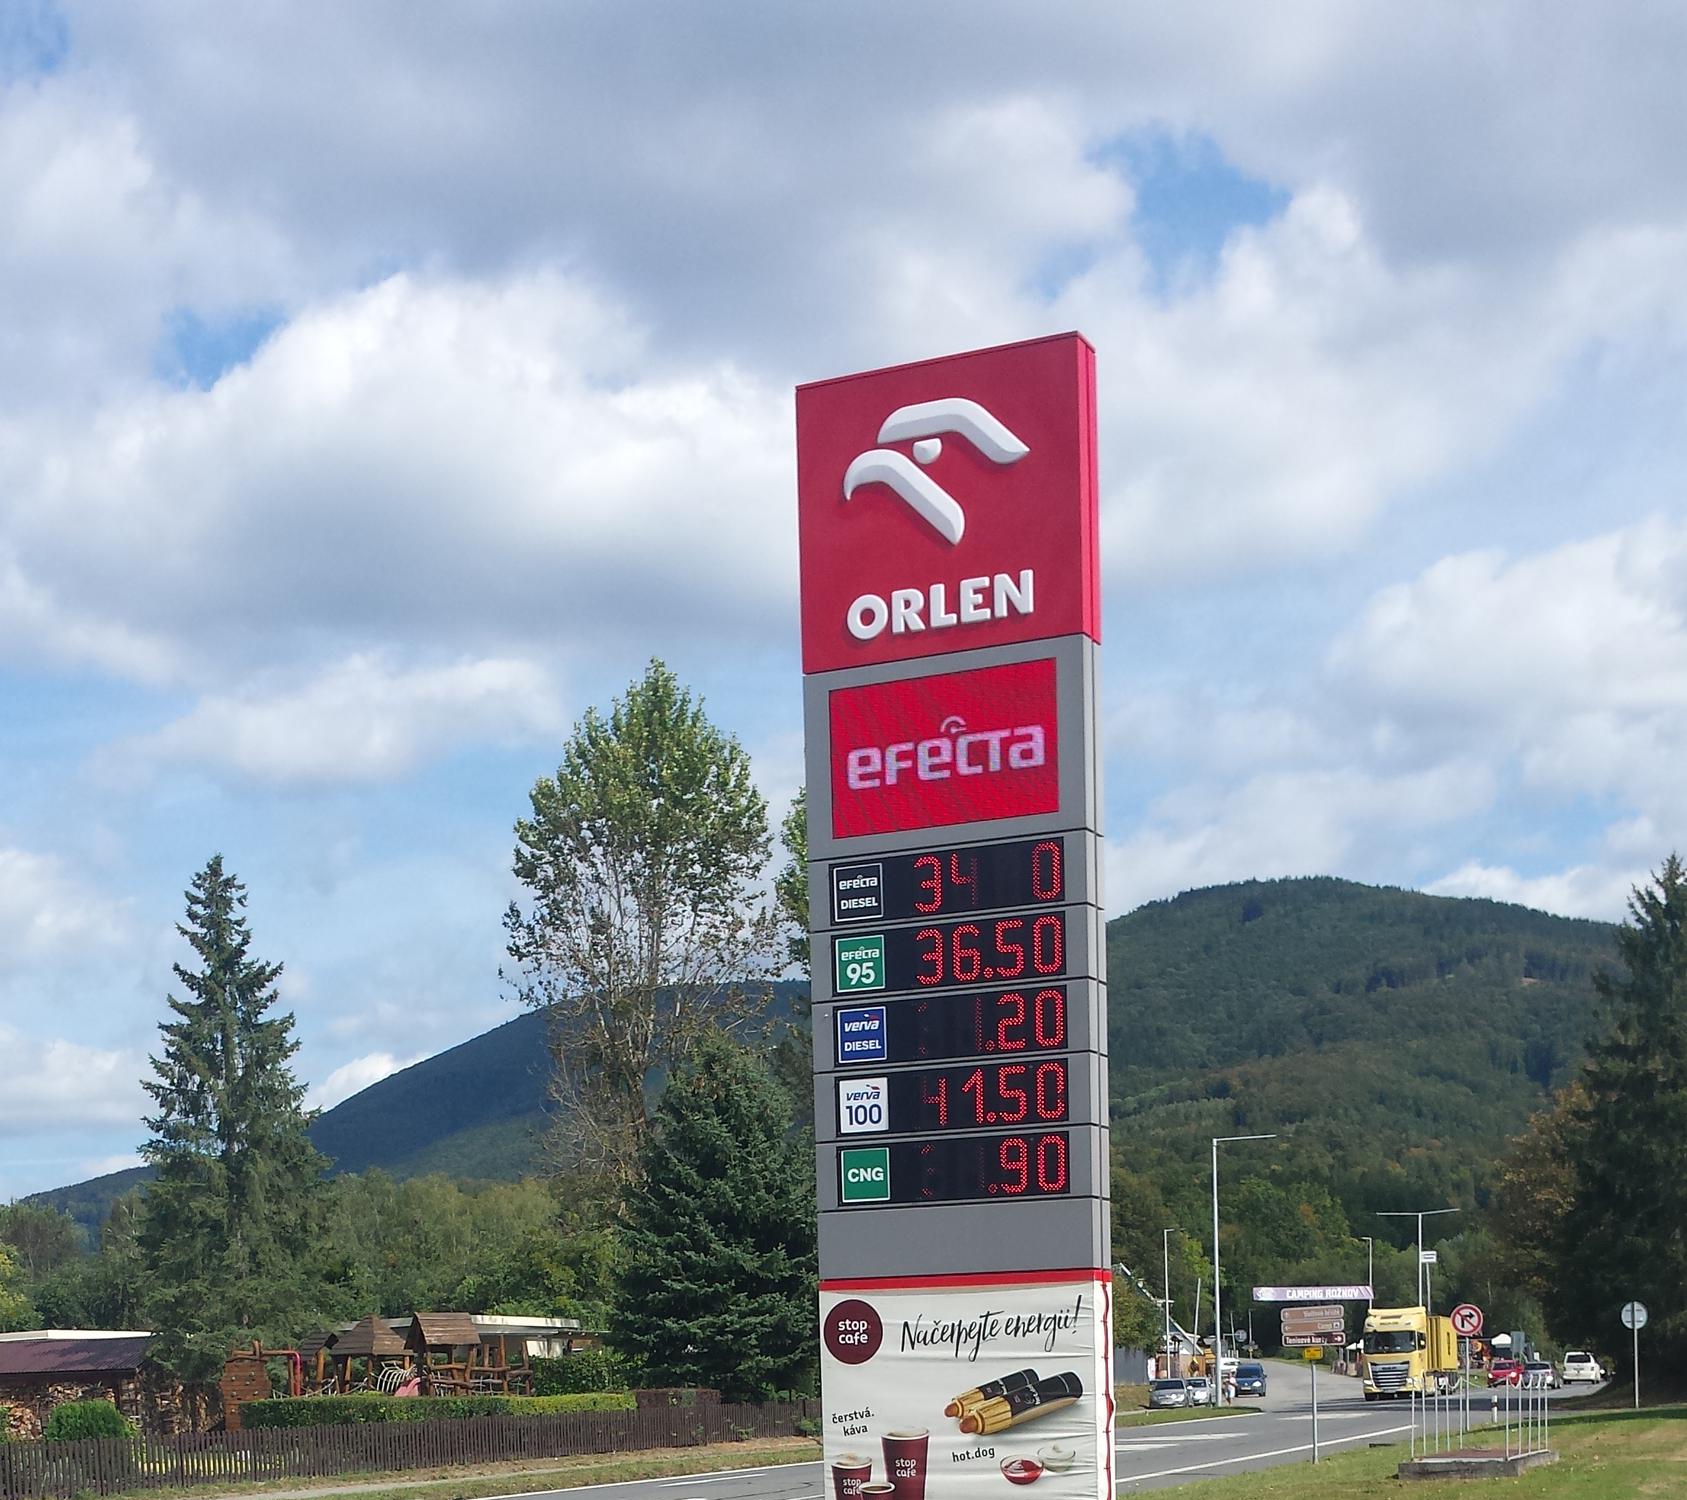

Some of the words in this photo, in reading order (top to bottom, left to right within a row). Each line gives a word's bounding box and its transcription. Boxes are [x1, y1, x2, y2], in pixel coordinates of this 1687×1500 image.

[847, 569, 1034, 640] ORLEN
[847, 717, 1045, 790] efecta
[839, 875, 878, 890] efecta
[841, 897, 878, 910] DIESEL
[841, 946, 880, 961] efecta
[916, 915, 1063, 985] 36.50
[846, 962, 875, 985] 95
[844, 1019, 880, 1032] verva
[845, 1040, 881, 1052] DIESEL
[846, 1090, 880, 1101] verva
[846, 1104, 882, 1126] 100
[847, 1167, 884, 1183] CNG
[1286, 1289, 1323, 1299] CAMPING
[837, 1319, 868, 1333] stop
[901, 1311, 1004, 1362] Načerpejte
[1004, 1294, 1083, 1352] energii!
[838, 1332, 868, 1345] cafe
[843, 1424, 868, 1437] káva
[895, 1458, 917, 1469] stop
[896, 1468, 917, 1478] cafe
[843, 1478, 862, 1487] stop
